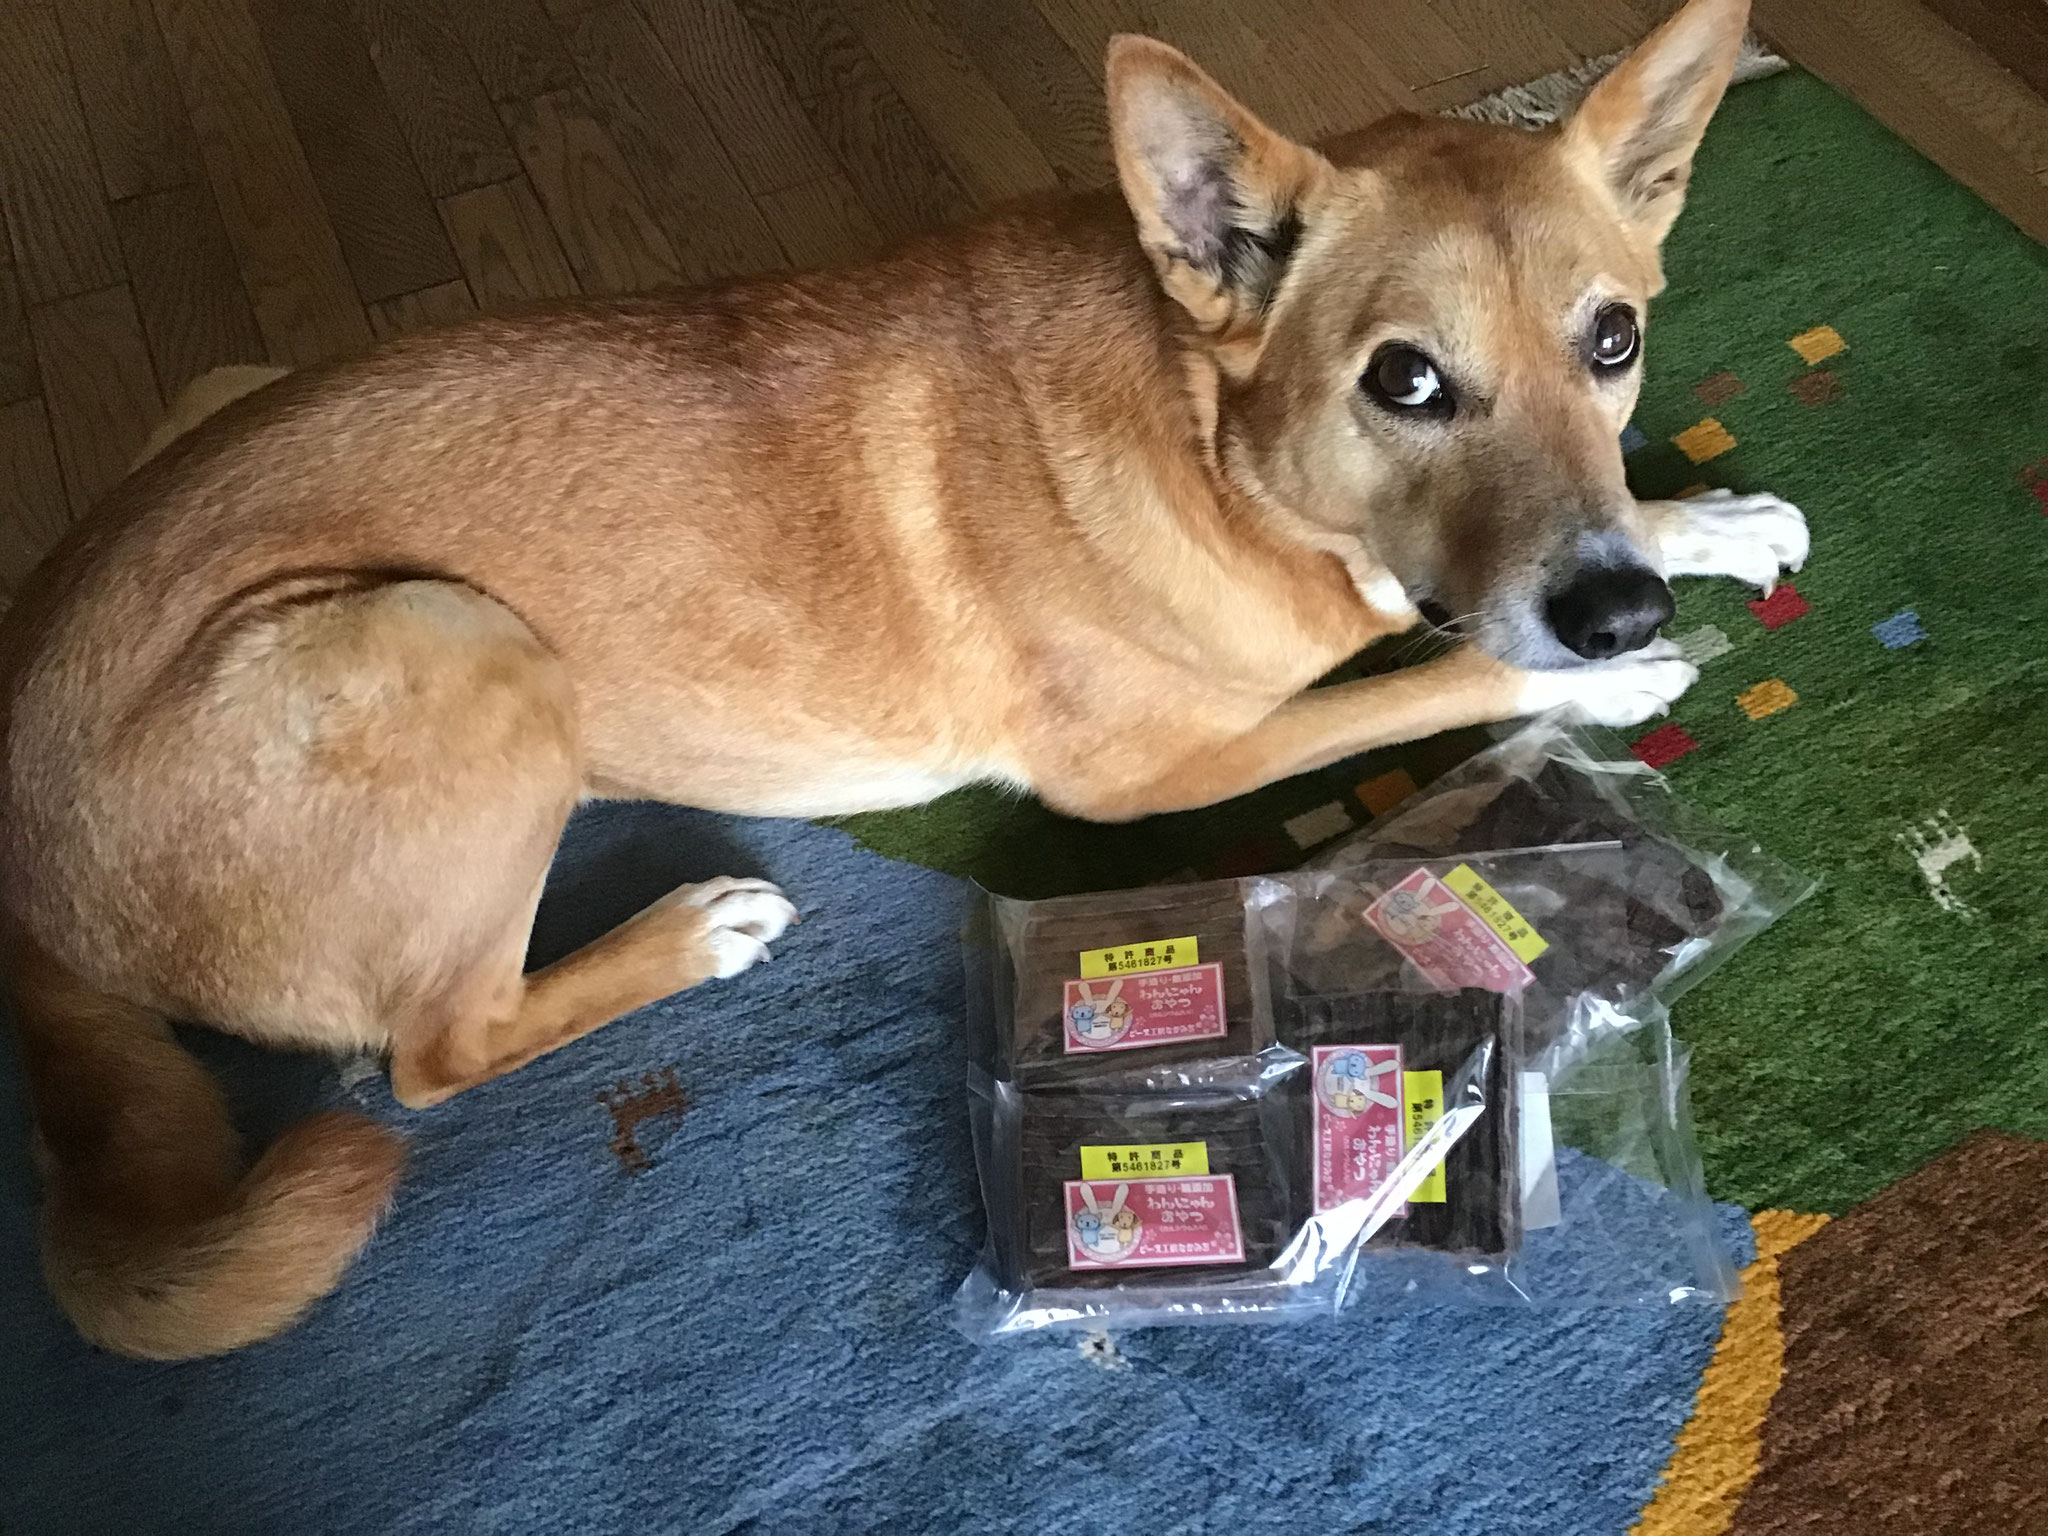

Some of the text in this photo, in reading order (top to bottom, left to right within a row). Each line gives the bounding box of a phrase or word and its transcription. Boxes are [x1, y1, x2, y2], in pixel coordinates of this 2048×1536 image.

[1104, 944, 1176, 962] 特許商品
[1108, 955, 1173, 972] 第5461827号
[1139, 984, 1203, 1000] わんにゃん
[1151, 998, 1191, 1010] おやつ
[1107, 1148, 1184, 1162] 特許商品
[1352, 1138, 1367, 1181] おやつ
[1367, 1125, 1382, 1193] わんにゃん
[1111, 1160, 1182, 1173] 第5461827号
[1147, 1196, 1215, 1210] わんにゃん
[1161, 1210, 1205, 1223] おやつ
